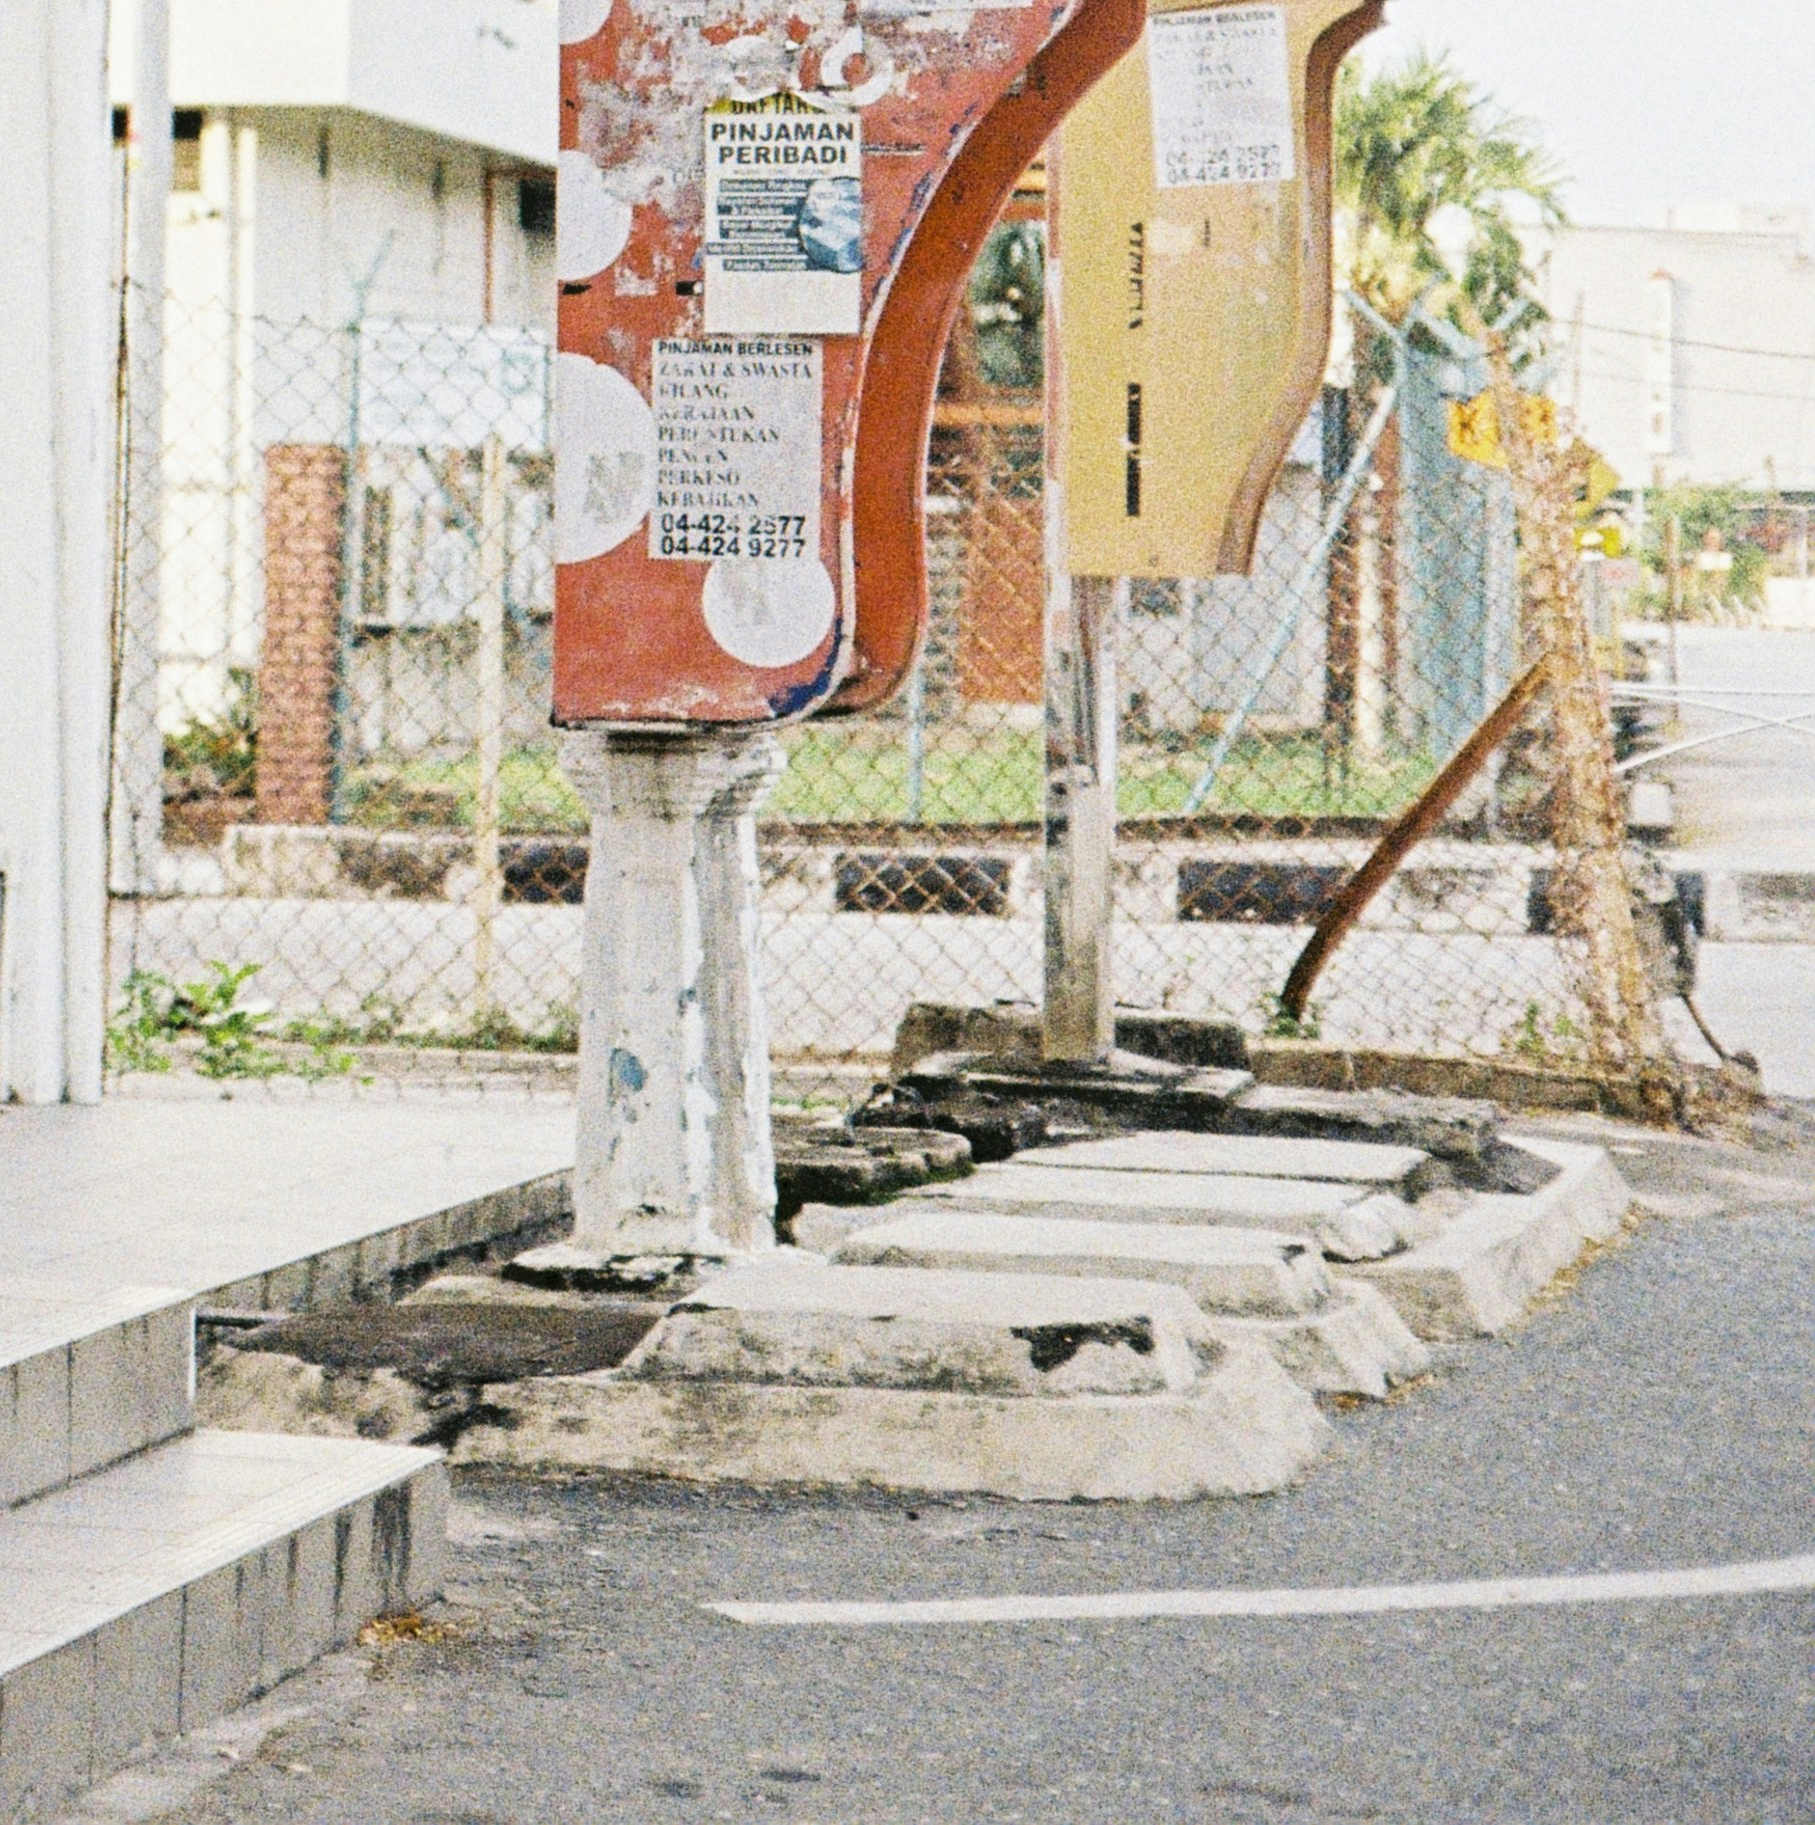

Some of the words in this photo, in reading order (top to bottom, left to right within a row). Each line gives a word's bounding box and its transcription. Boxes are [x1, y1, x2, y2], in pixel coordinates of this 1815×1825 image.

[711, 121, 855, 142] PINJAMAN
[718, 144, 848, 165] PERIBADI
[657, 340, 734, 355] PINJAMAN
[736, 341, 814, 356] BERLESEN
[721, 361, 735, 378] &
[741, 361, 813, 379] SWASTA
[661, 535, 742, 557] 04-424
[747, 537, 807, 559] 9277
